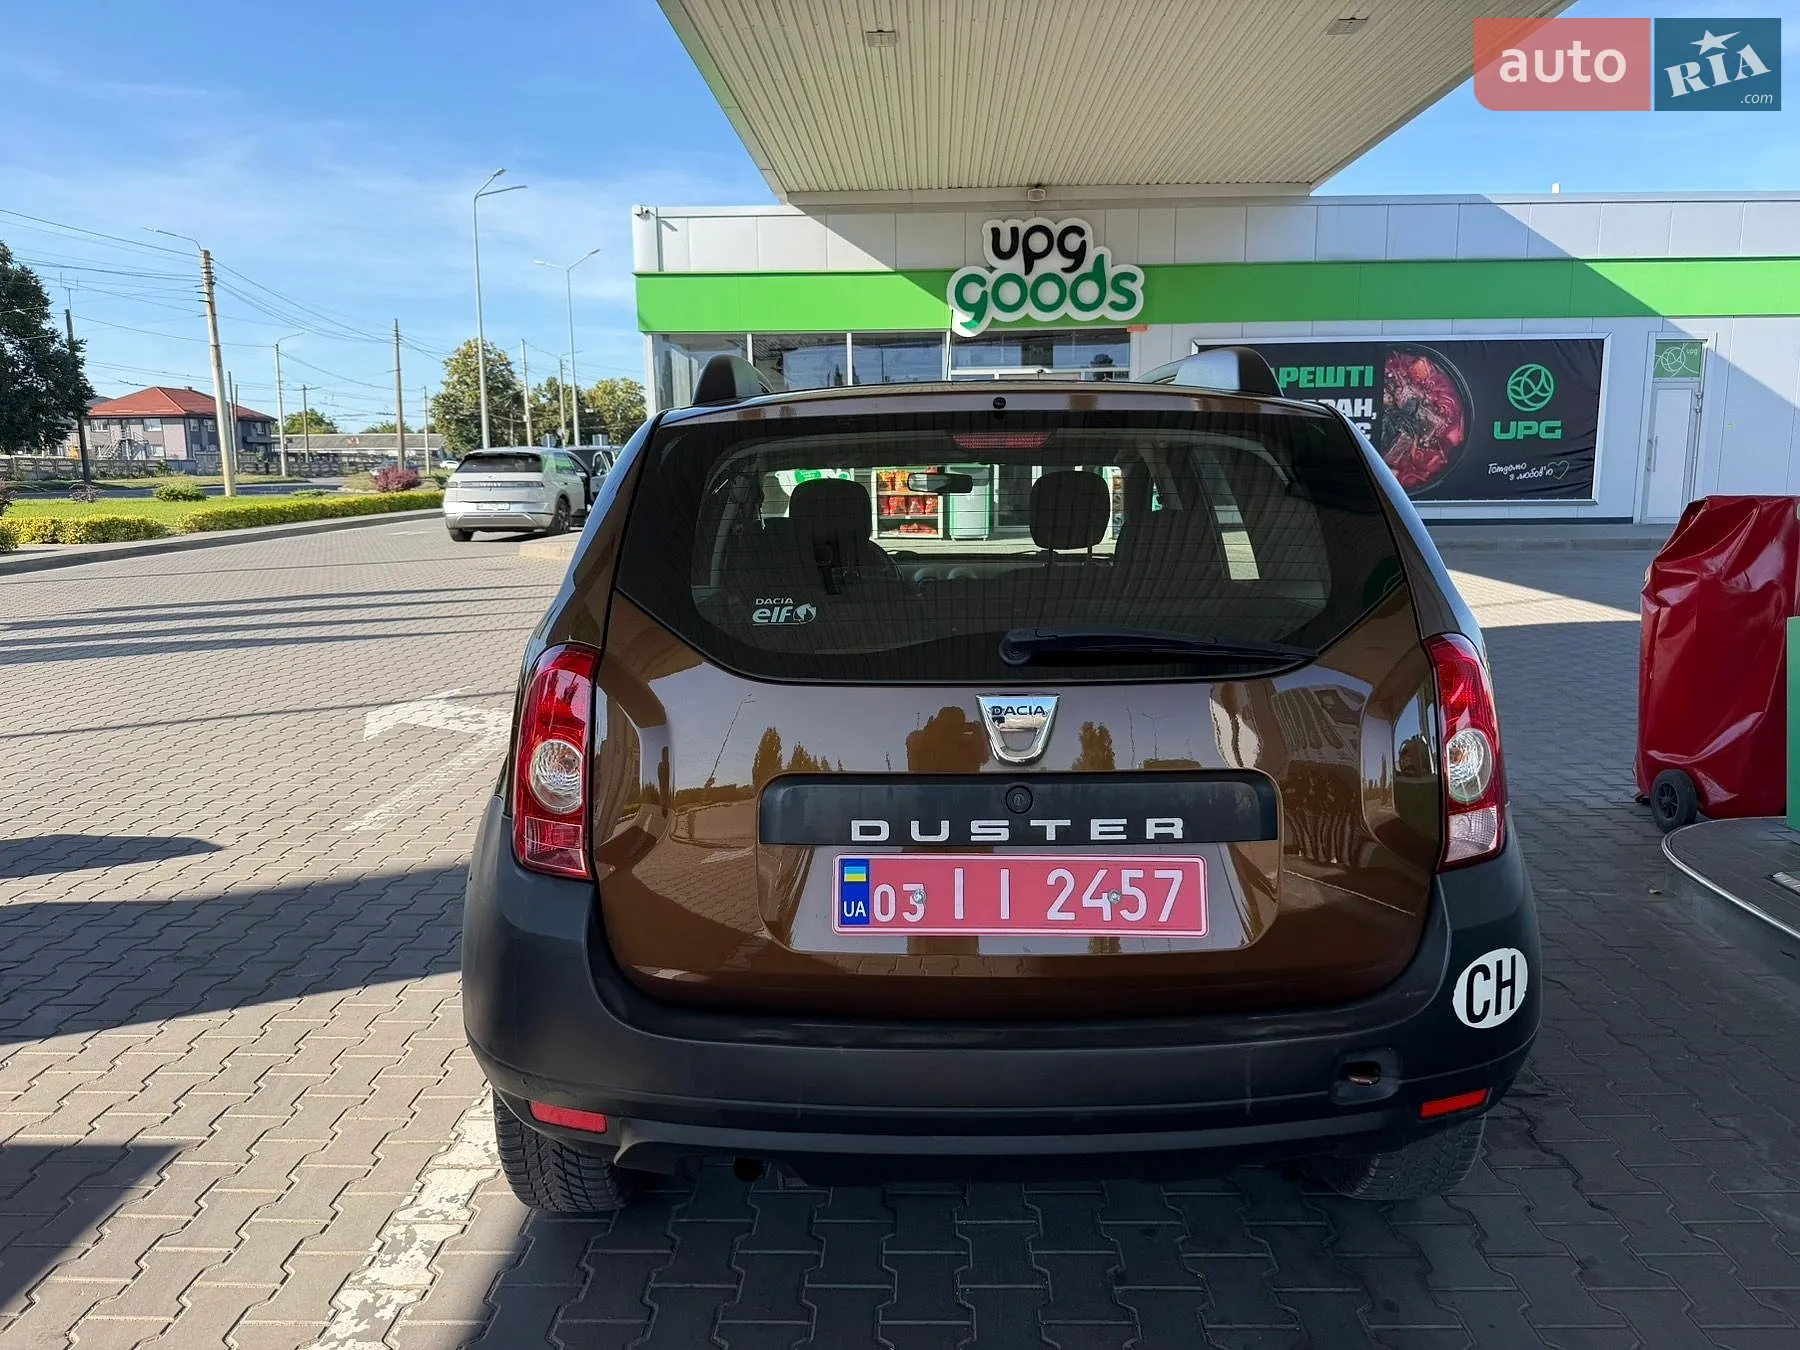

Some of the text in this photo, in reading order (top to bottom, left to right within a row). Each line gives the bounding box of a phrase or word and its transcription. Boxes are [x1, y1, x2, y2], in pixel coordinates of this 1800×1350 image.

[990, 224, 1087, 276] upg
[954, 253, 1138, 329] goods
[1271, 366, 1374, 388] РЕШТІ
[1493, 420, 1562, 440] UPG
[752, 606, 794, 623] elf
[991, 705, 1046, 716] DACIA
[851, 818, 1185, 842] DUSTER
[873, 883, 926, 923] 03
[1046, 868, 1184, 922] 2457
[843, 900, 867, 918] UA
[1465, 954, 1517, 1024] CH
